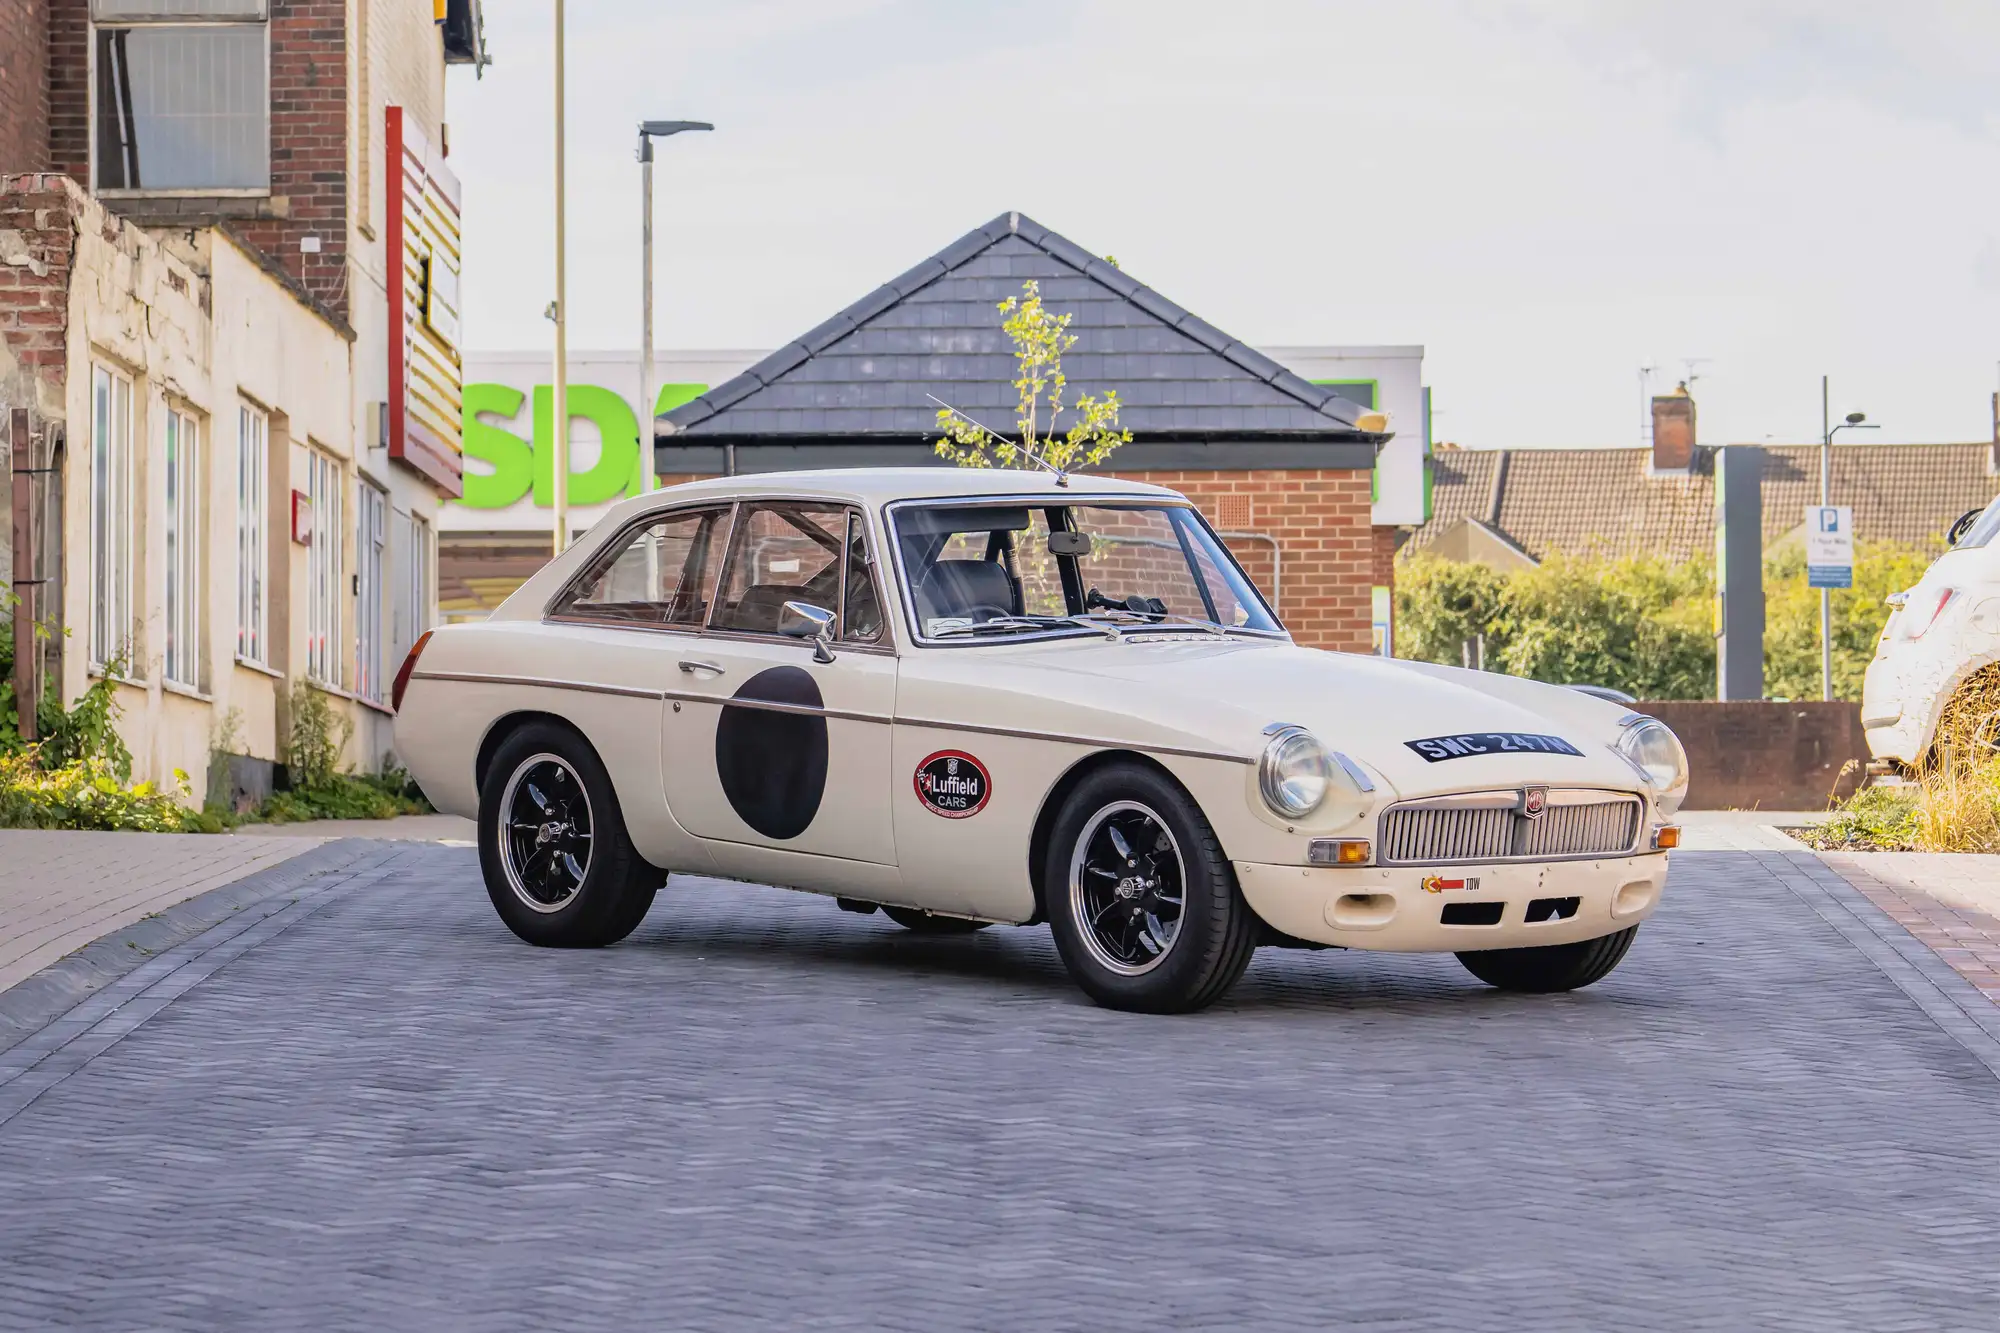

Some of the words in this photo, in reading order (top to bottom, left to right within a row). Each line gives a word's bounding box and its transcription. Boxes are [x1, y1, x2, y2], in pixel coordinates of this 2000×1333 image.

[1416, 736, 1487, 758] SWC
[933, 775, 978, 795] Luffield
[937, 795, 967, 808] CARS
[1465, 877, 1481, 891] TOW
